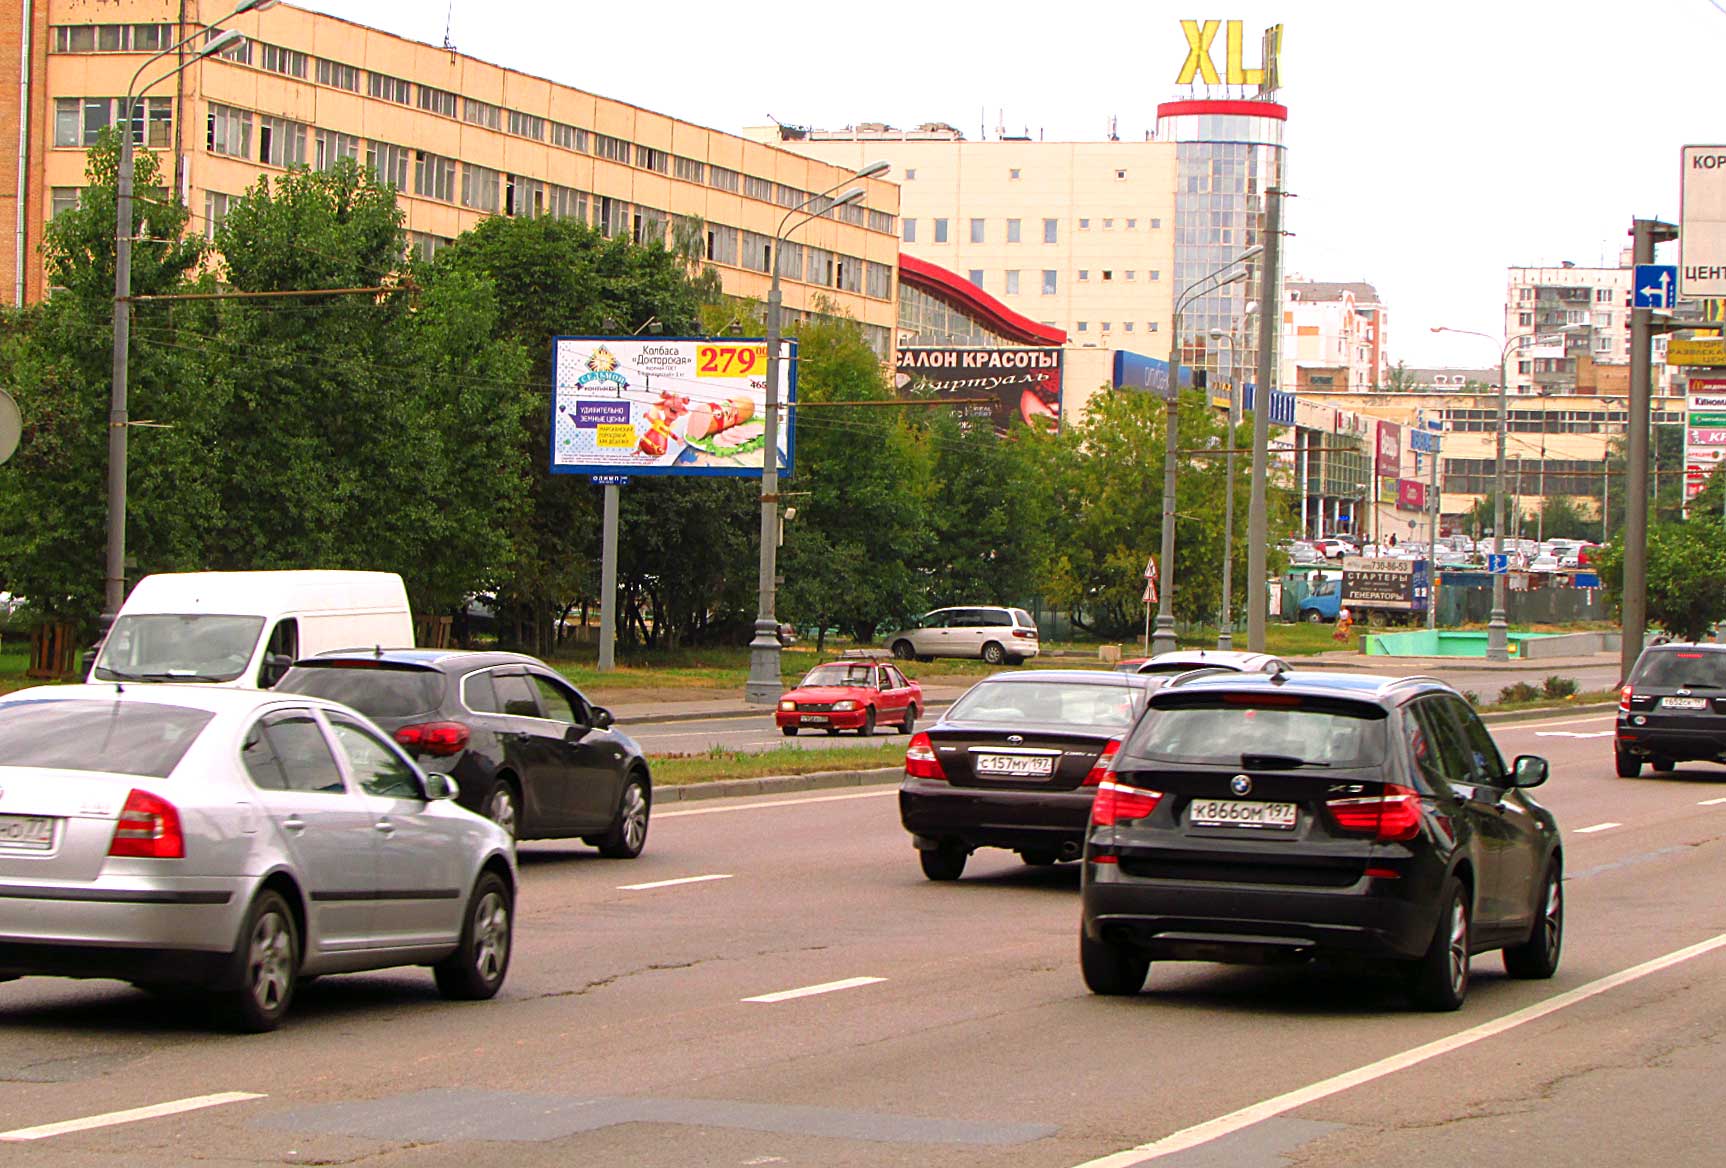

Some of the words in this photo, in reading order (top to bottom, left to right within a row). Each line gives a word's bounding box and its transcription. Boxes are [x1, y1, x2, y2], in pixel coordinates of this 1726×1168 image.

[1175, 19, 1264, 85] XL
[642, 345, 679, 356] Колбаса
[701, 347, 756, 374] 279
[962, 351, 1058, 367] КРАСОТЫ
[1347, 572, 1408, 582] СТАРТЕРЫ
[1349, 591, 1405, 601] ГЕНЕРАТОРЫ
[1032, 758, 1049, 767] 197
[1328, 784, 1364, 793] X3
[1196, 802, 1263, 820] К866ОМ
[1266, 803, 1291, 817] 197
